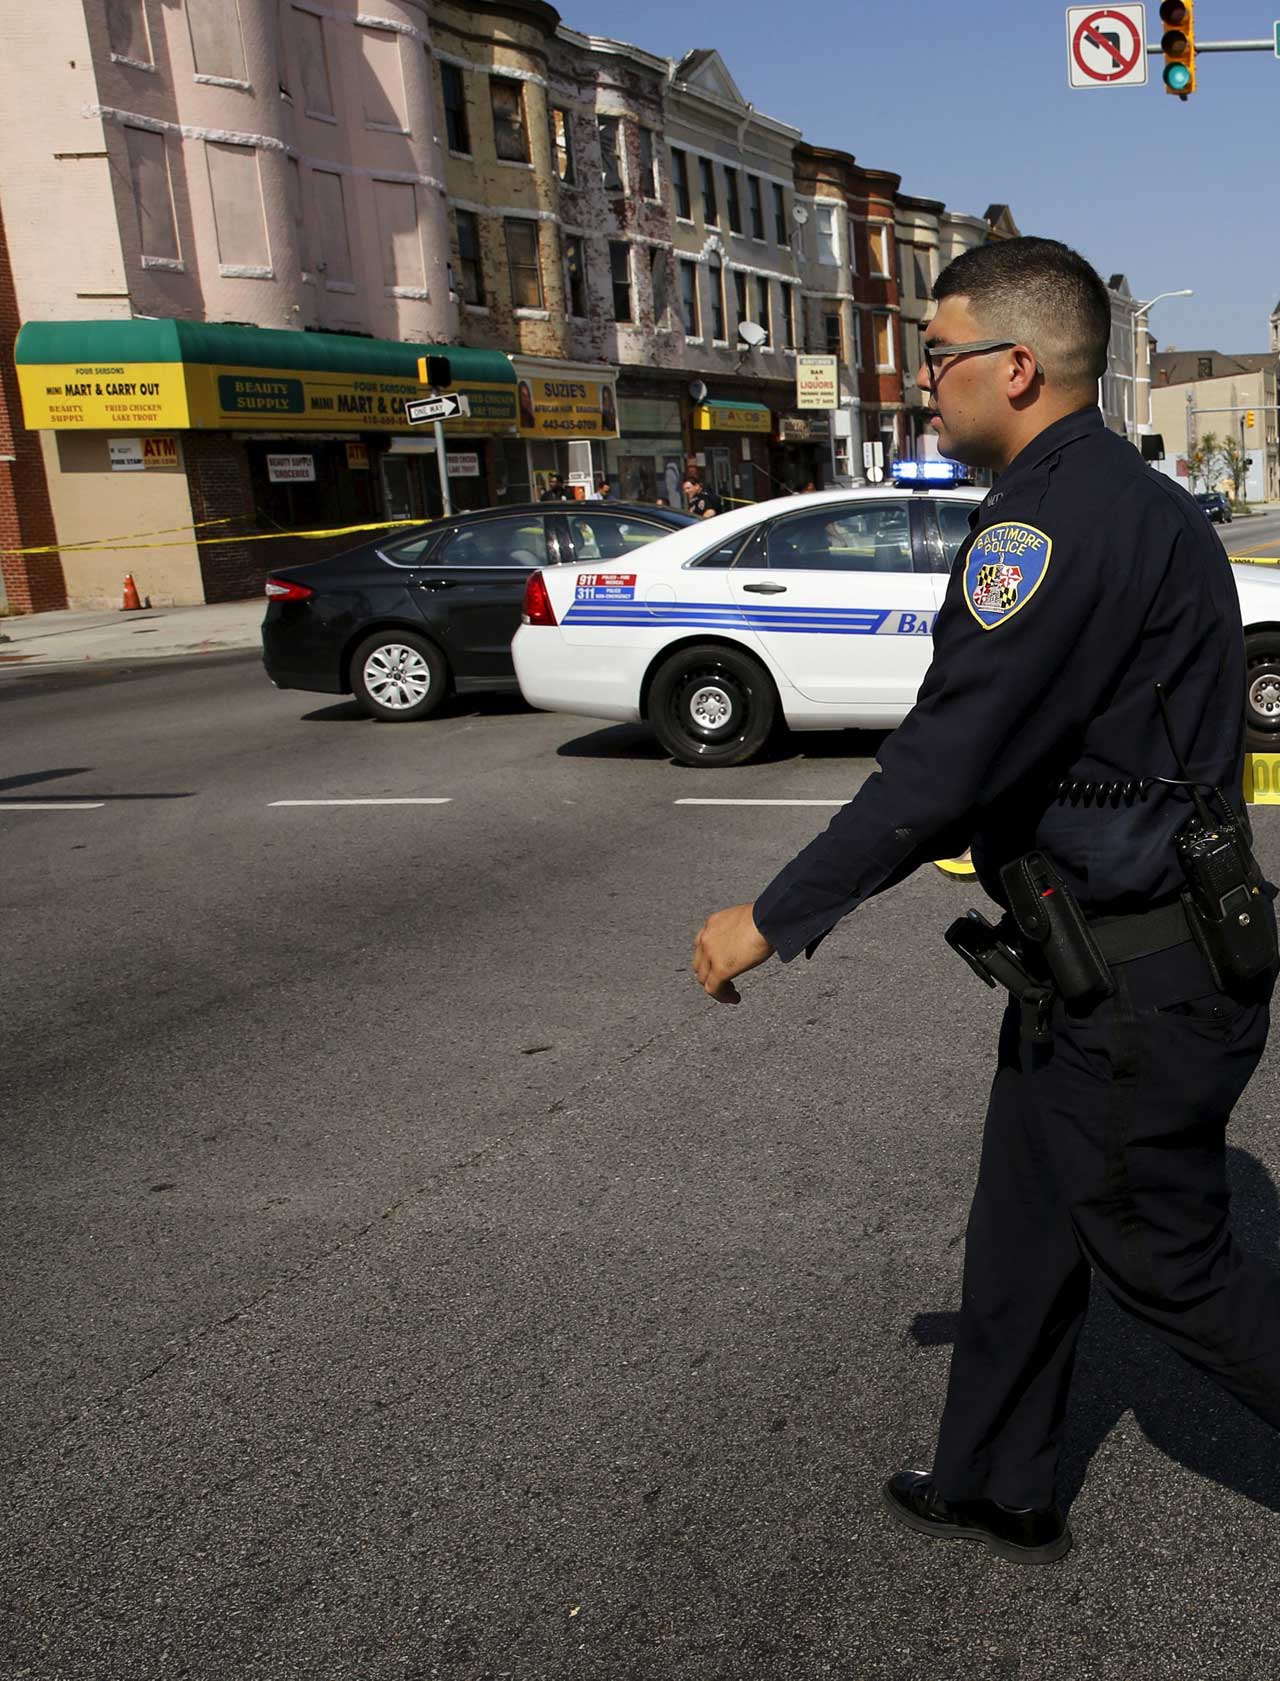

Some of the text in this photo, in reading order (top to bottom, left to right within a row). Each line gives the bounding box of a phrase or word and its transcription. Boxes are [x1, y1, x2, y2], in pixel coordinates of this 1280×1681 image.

[65, 383, 92, 397] MART
[95, 384, 104, 396] &
[105, 383, 137, 396] CARRY
[140, 383, 160, 396] OUT
[234, 381, 289, 394] BEAUTY
[543, 382, 586, 398] SUZIE'S
[800, 381, 834, 389] LIQUORS
[105, 404, 162, 412] FRIED CHICKEN
[237, 396, 289, 409] SUPPLY
[310, 396, 334, 410] MINI
[337, 394, 373, 413] MART
[377, 396, 387, 414] &
[49, 405, 83, 413] BEAUTY
[413, 404, 444, 416] ONE WAY
[51, 414, 84, 422] SUPPLY
[112, 414, 158, 422] LAKE TROUT
[144, 438, 177, 457] ATM
[977, 527, 1044, 551] BALTIMORE
[984, 540, 1028, 556] POLICE
[578, 575, 597, 586] 911
[577, 587, 595, 599] 311
